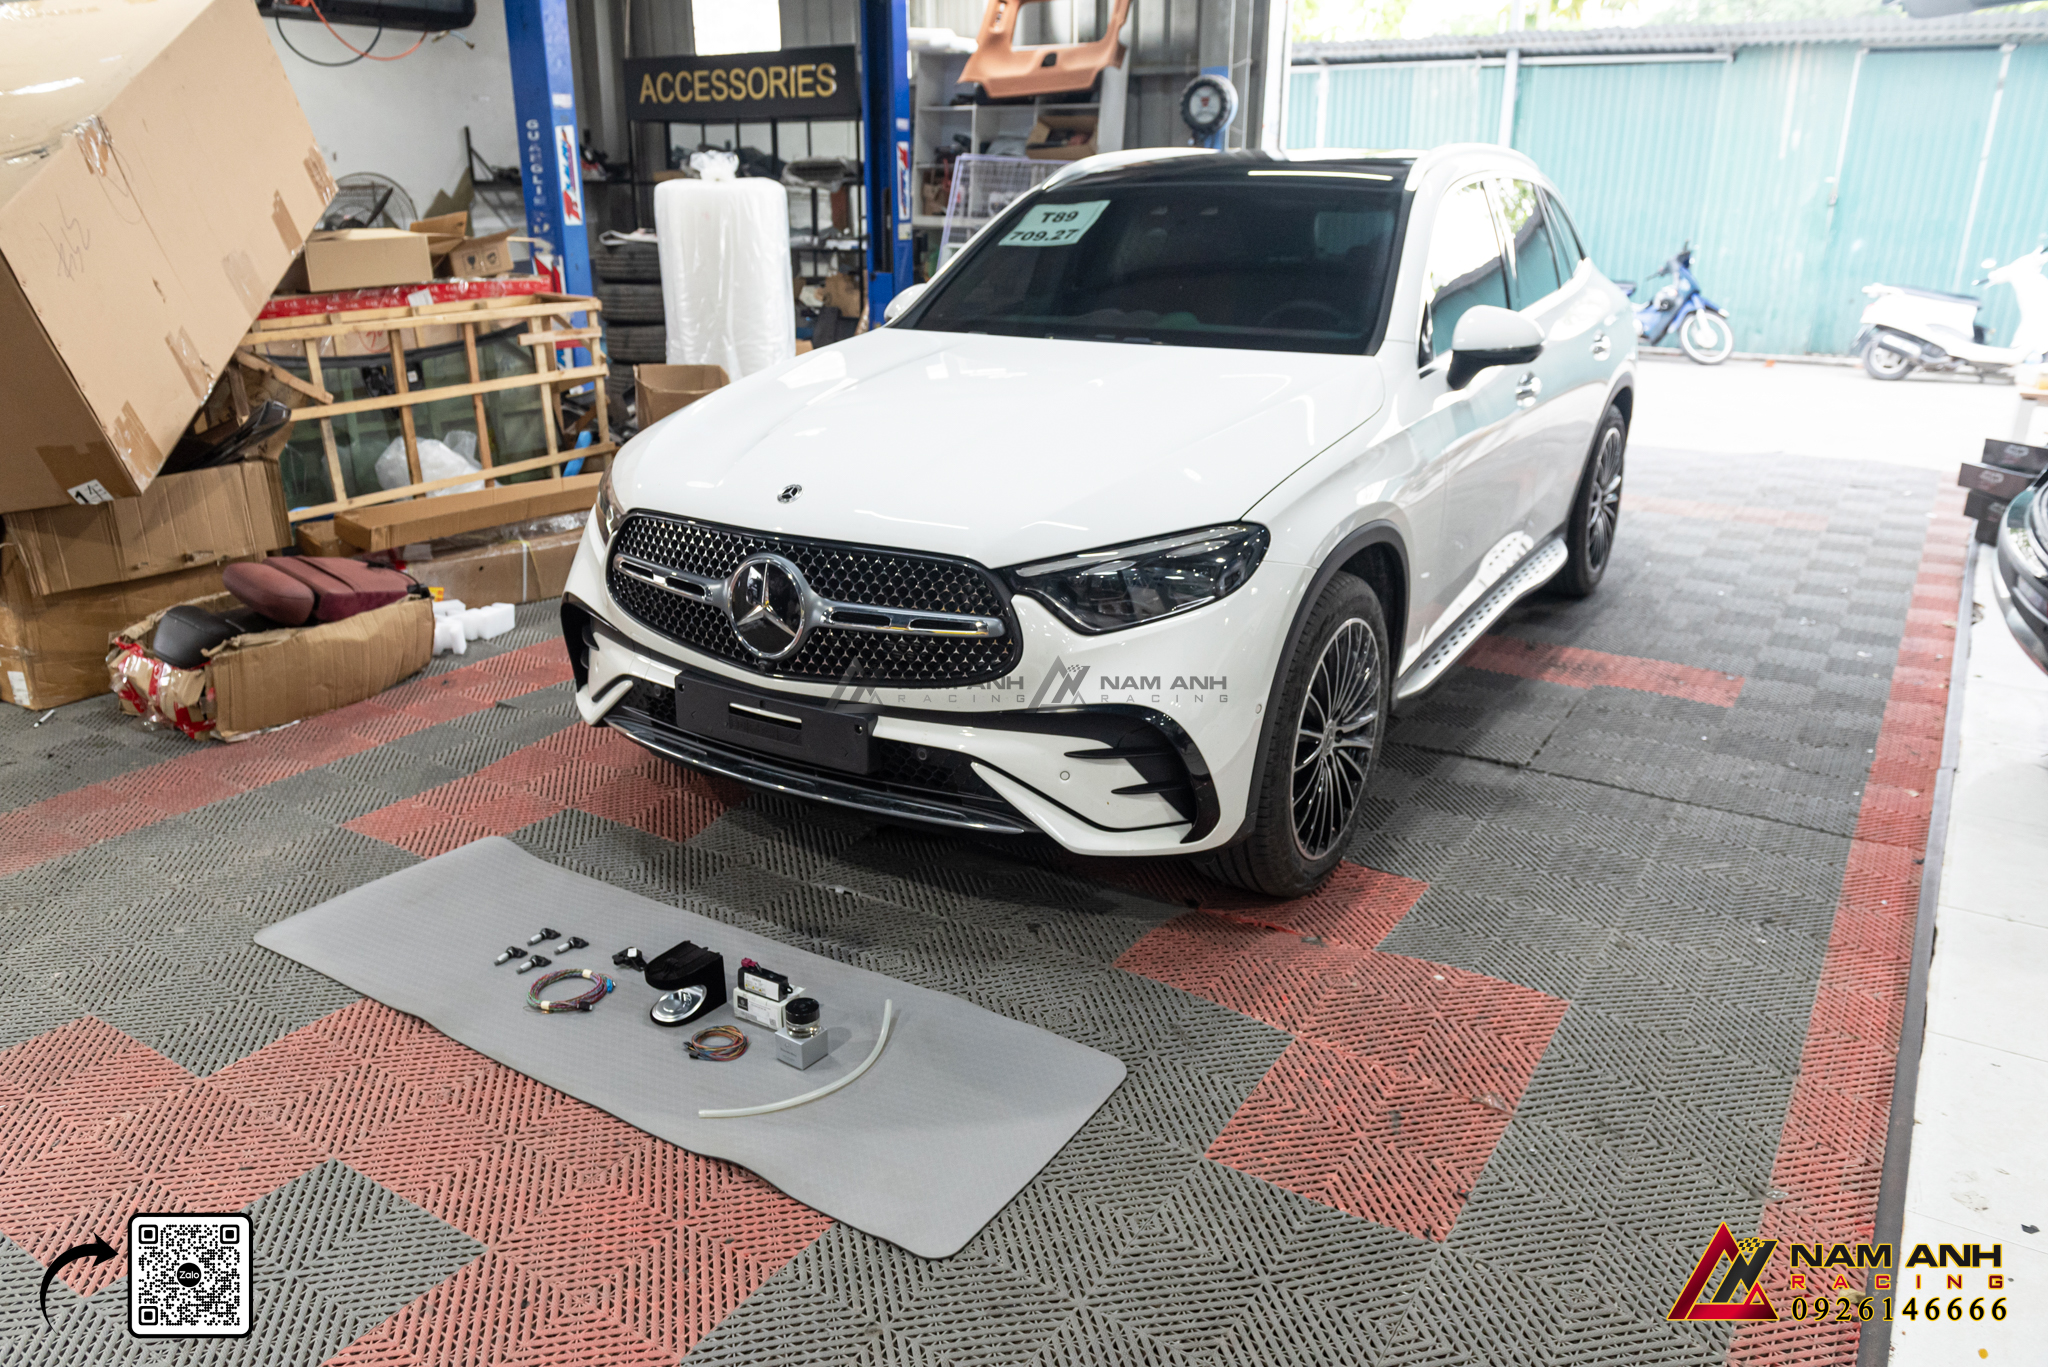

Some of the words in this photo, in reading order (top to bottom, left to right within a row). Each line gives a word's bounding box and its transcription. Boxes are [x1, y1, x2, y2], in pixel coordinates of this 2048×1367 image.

[639, 62, 837, 104] ACCESSORIES
[1041, 211, 1079, 223] T89
[1010, 229, 1080, 241] 709.27
